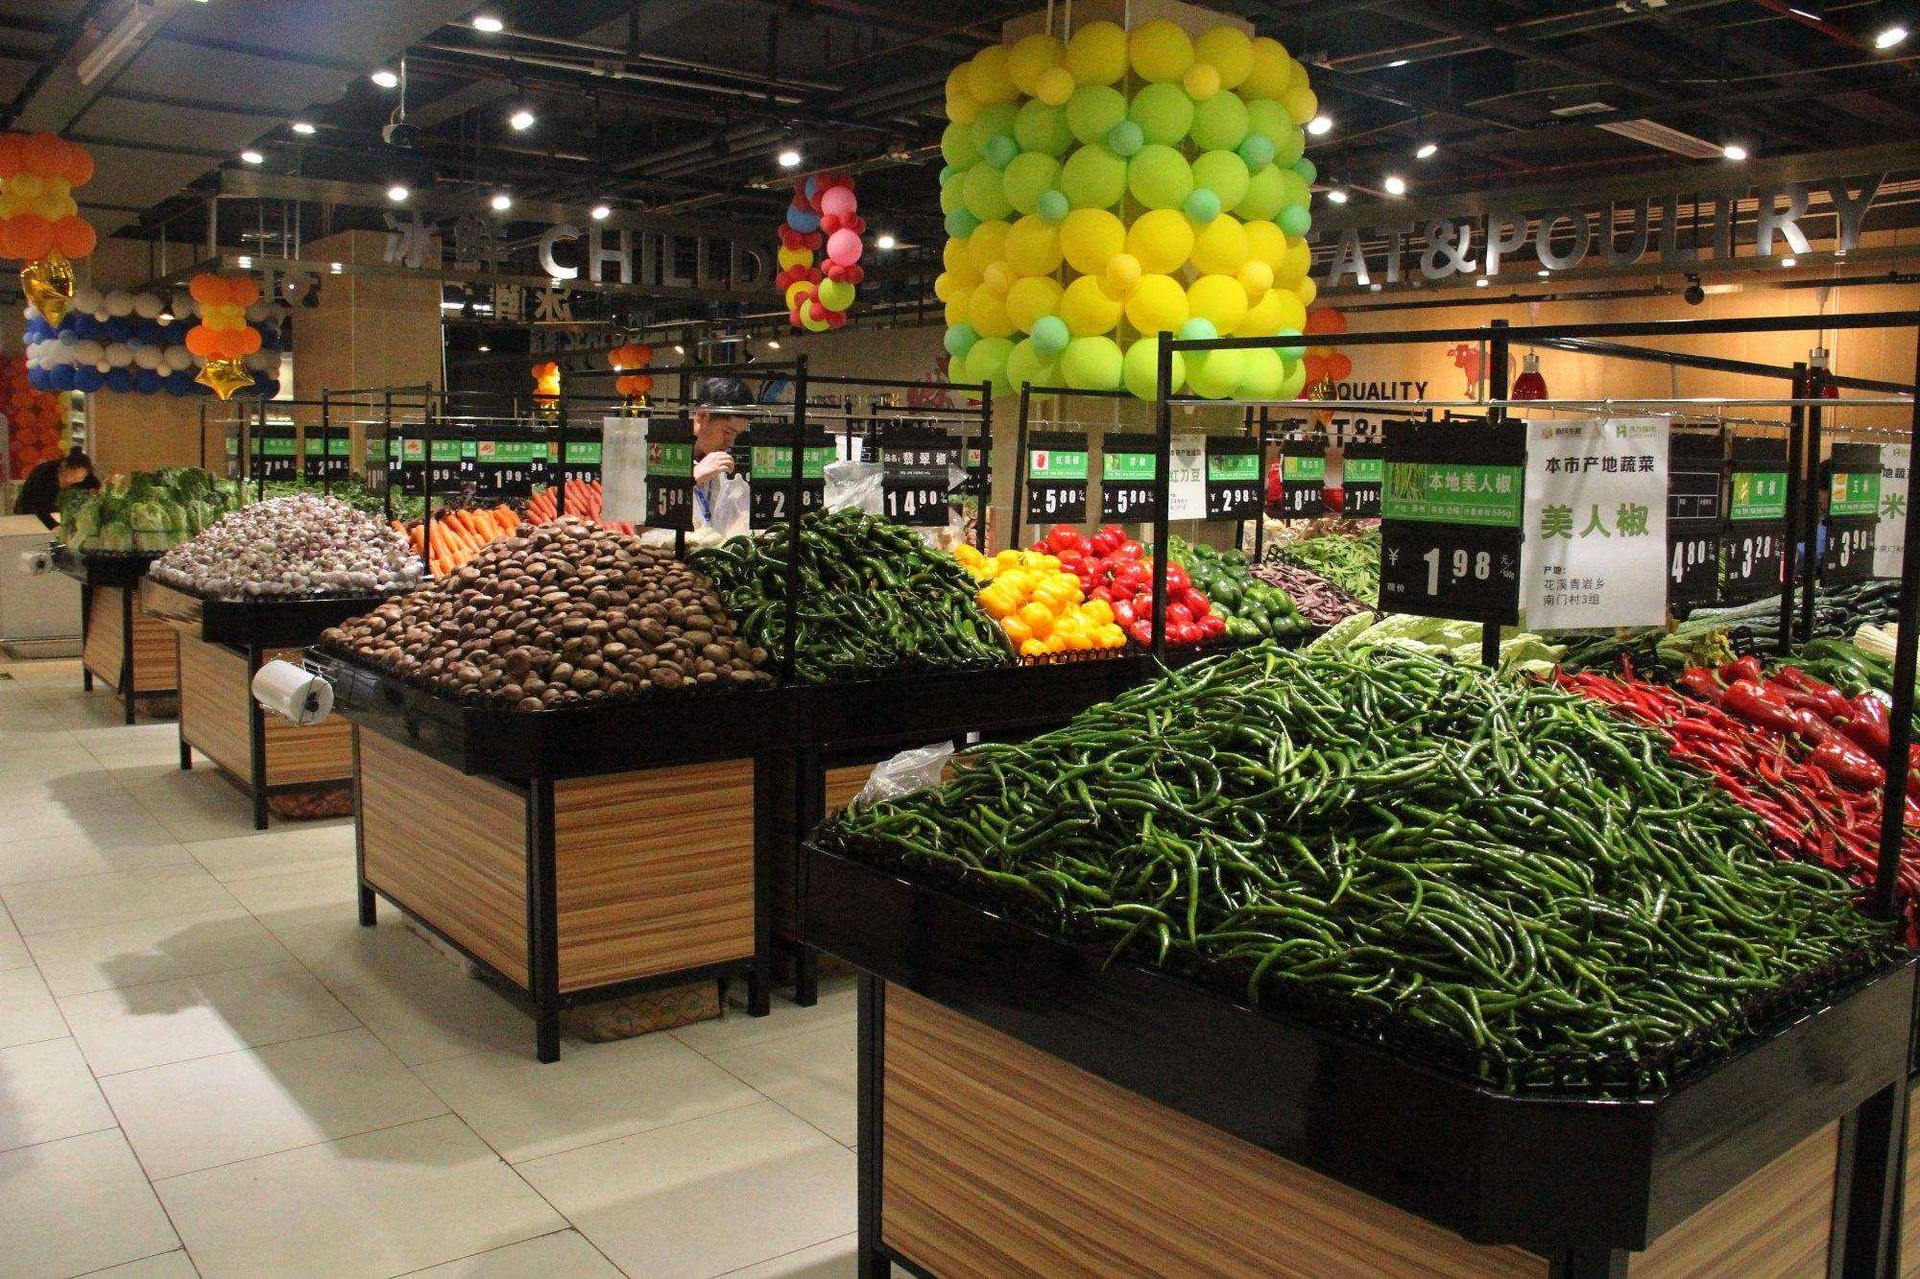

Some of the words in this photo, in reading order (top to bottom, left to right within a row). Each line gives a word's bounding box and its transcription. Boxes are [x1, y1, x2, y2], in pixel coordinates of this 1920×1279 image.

[1307, 172, 1889, 288] AT&POULTRY
[1337, 382, 1427, 400] QUALITY
[1545, 456, 1655, 474] 本市产地蔬菜
[1429, 471, 1511, 494] 本地美人椒
[887, 489, 938, 517] 14.80
[1045, 489, 1076, 514] 5.80
[1117, 490, 1146, 514] 5.80
[1222, 489, 1249, 512] 2.98
[1540, 503, 1650, 540] 美人椒
[1672, 540, 1706, 583] 4.80
[1741, 535, 1771, 579] 3.28
[1423, 547, 1491, 597] 1.98
[1543, 594, 1600, 607] 南门村3组
